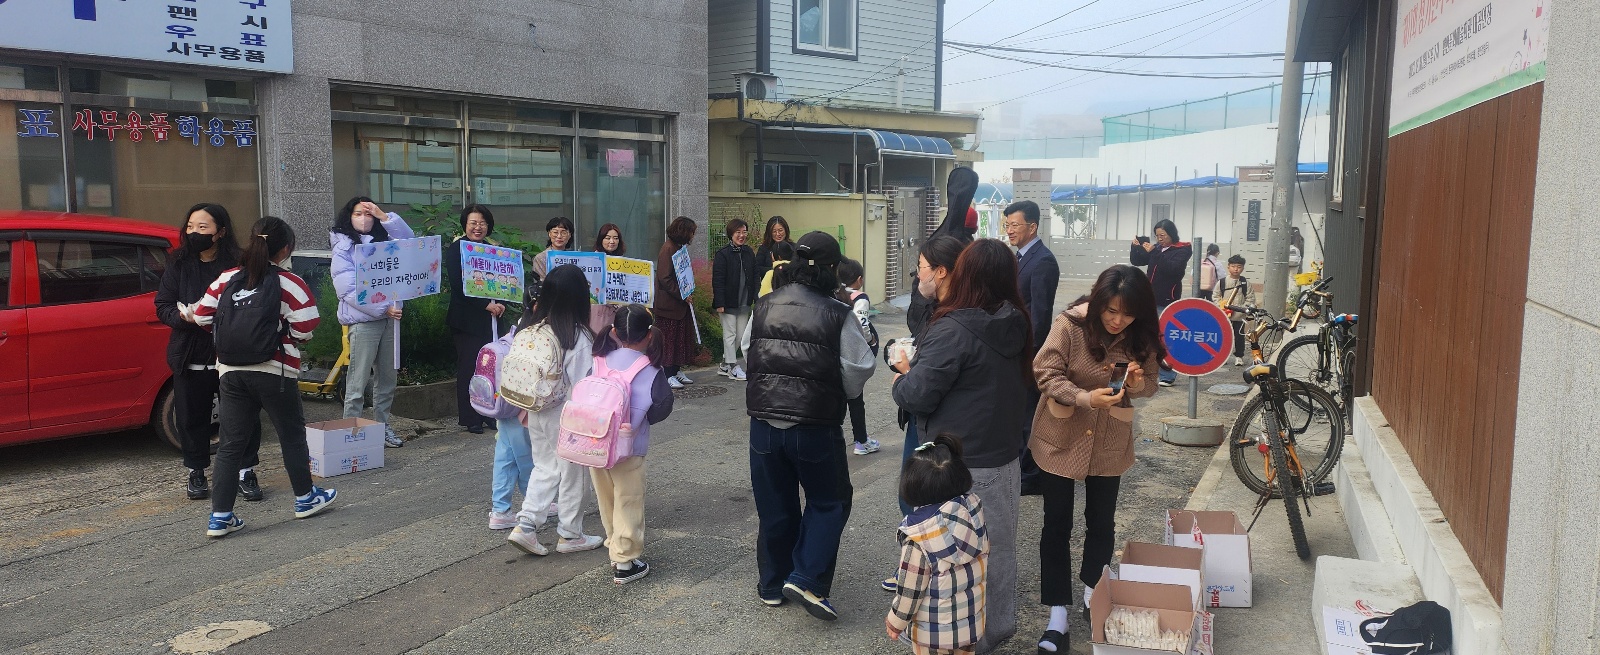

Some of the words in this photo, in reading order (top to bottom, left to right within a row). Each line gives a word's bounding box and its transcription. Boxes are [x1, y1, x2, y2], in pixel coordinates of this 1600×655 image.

[167, 42, 266, 63] 사무용품
[17, 109, 59, 138] 표
[72, 109, 172, 142] 사무용품
[175, 116, 257, 147] 학용품
[370, 257, 400, 272] 너희들은
[370, 276, 393, 289] 우리의
[860, 317, 868, 327] 2
